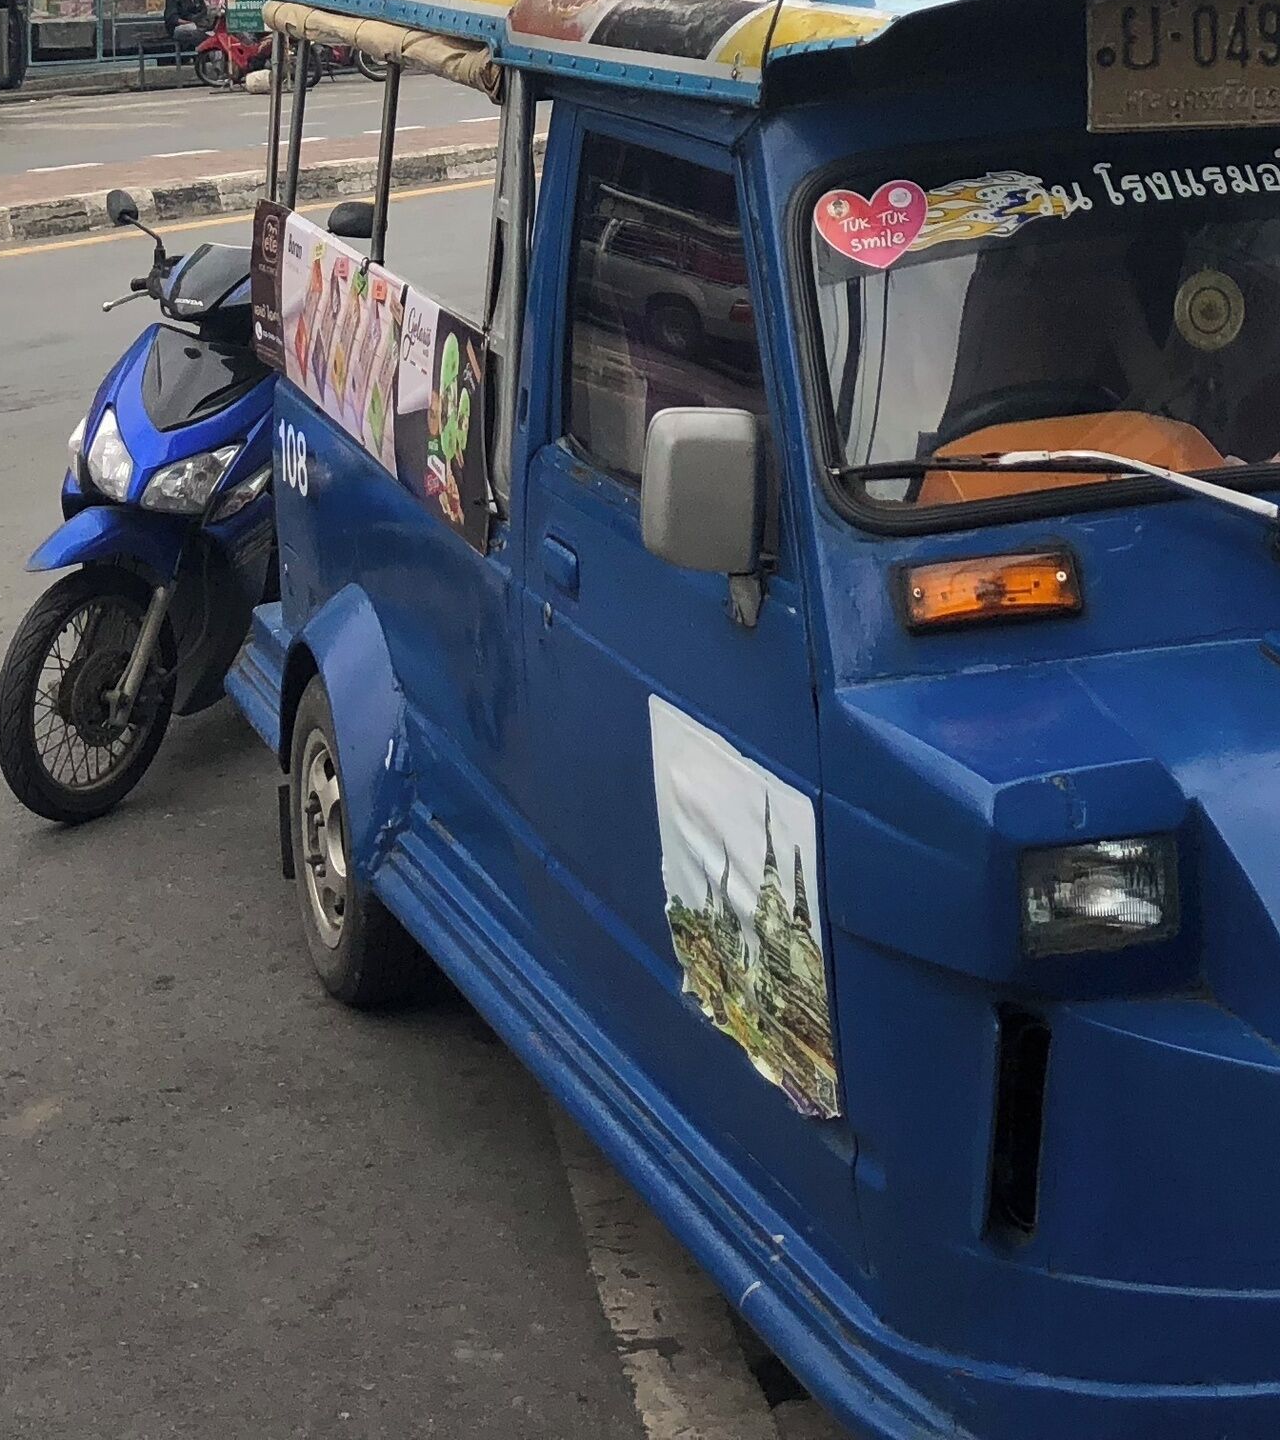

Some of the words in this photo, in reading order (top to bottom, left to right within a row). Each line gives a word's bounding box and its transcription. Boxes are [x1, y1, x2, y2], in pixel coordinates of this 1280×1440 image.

[838, 215, 873, 234] TUK
[876, 210, 911, 227] TUK
[849, 229, 907, 253] smile
[174, 297, 204, 307] HONDA
[278, 417, 309, 497] 108
